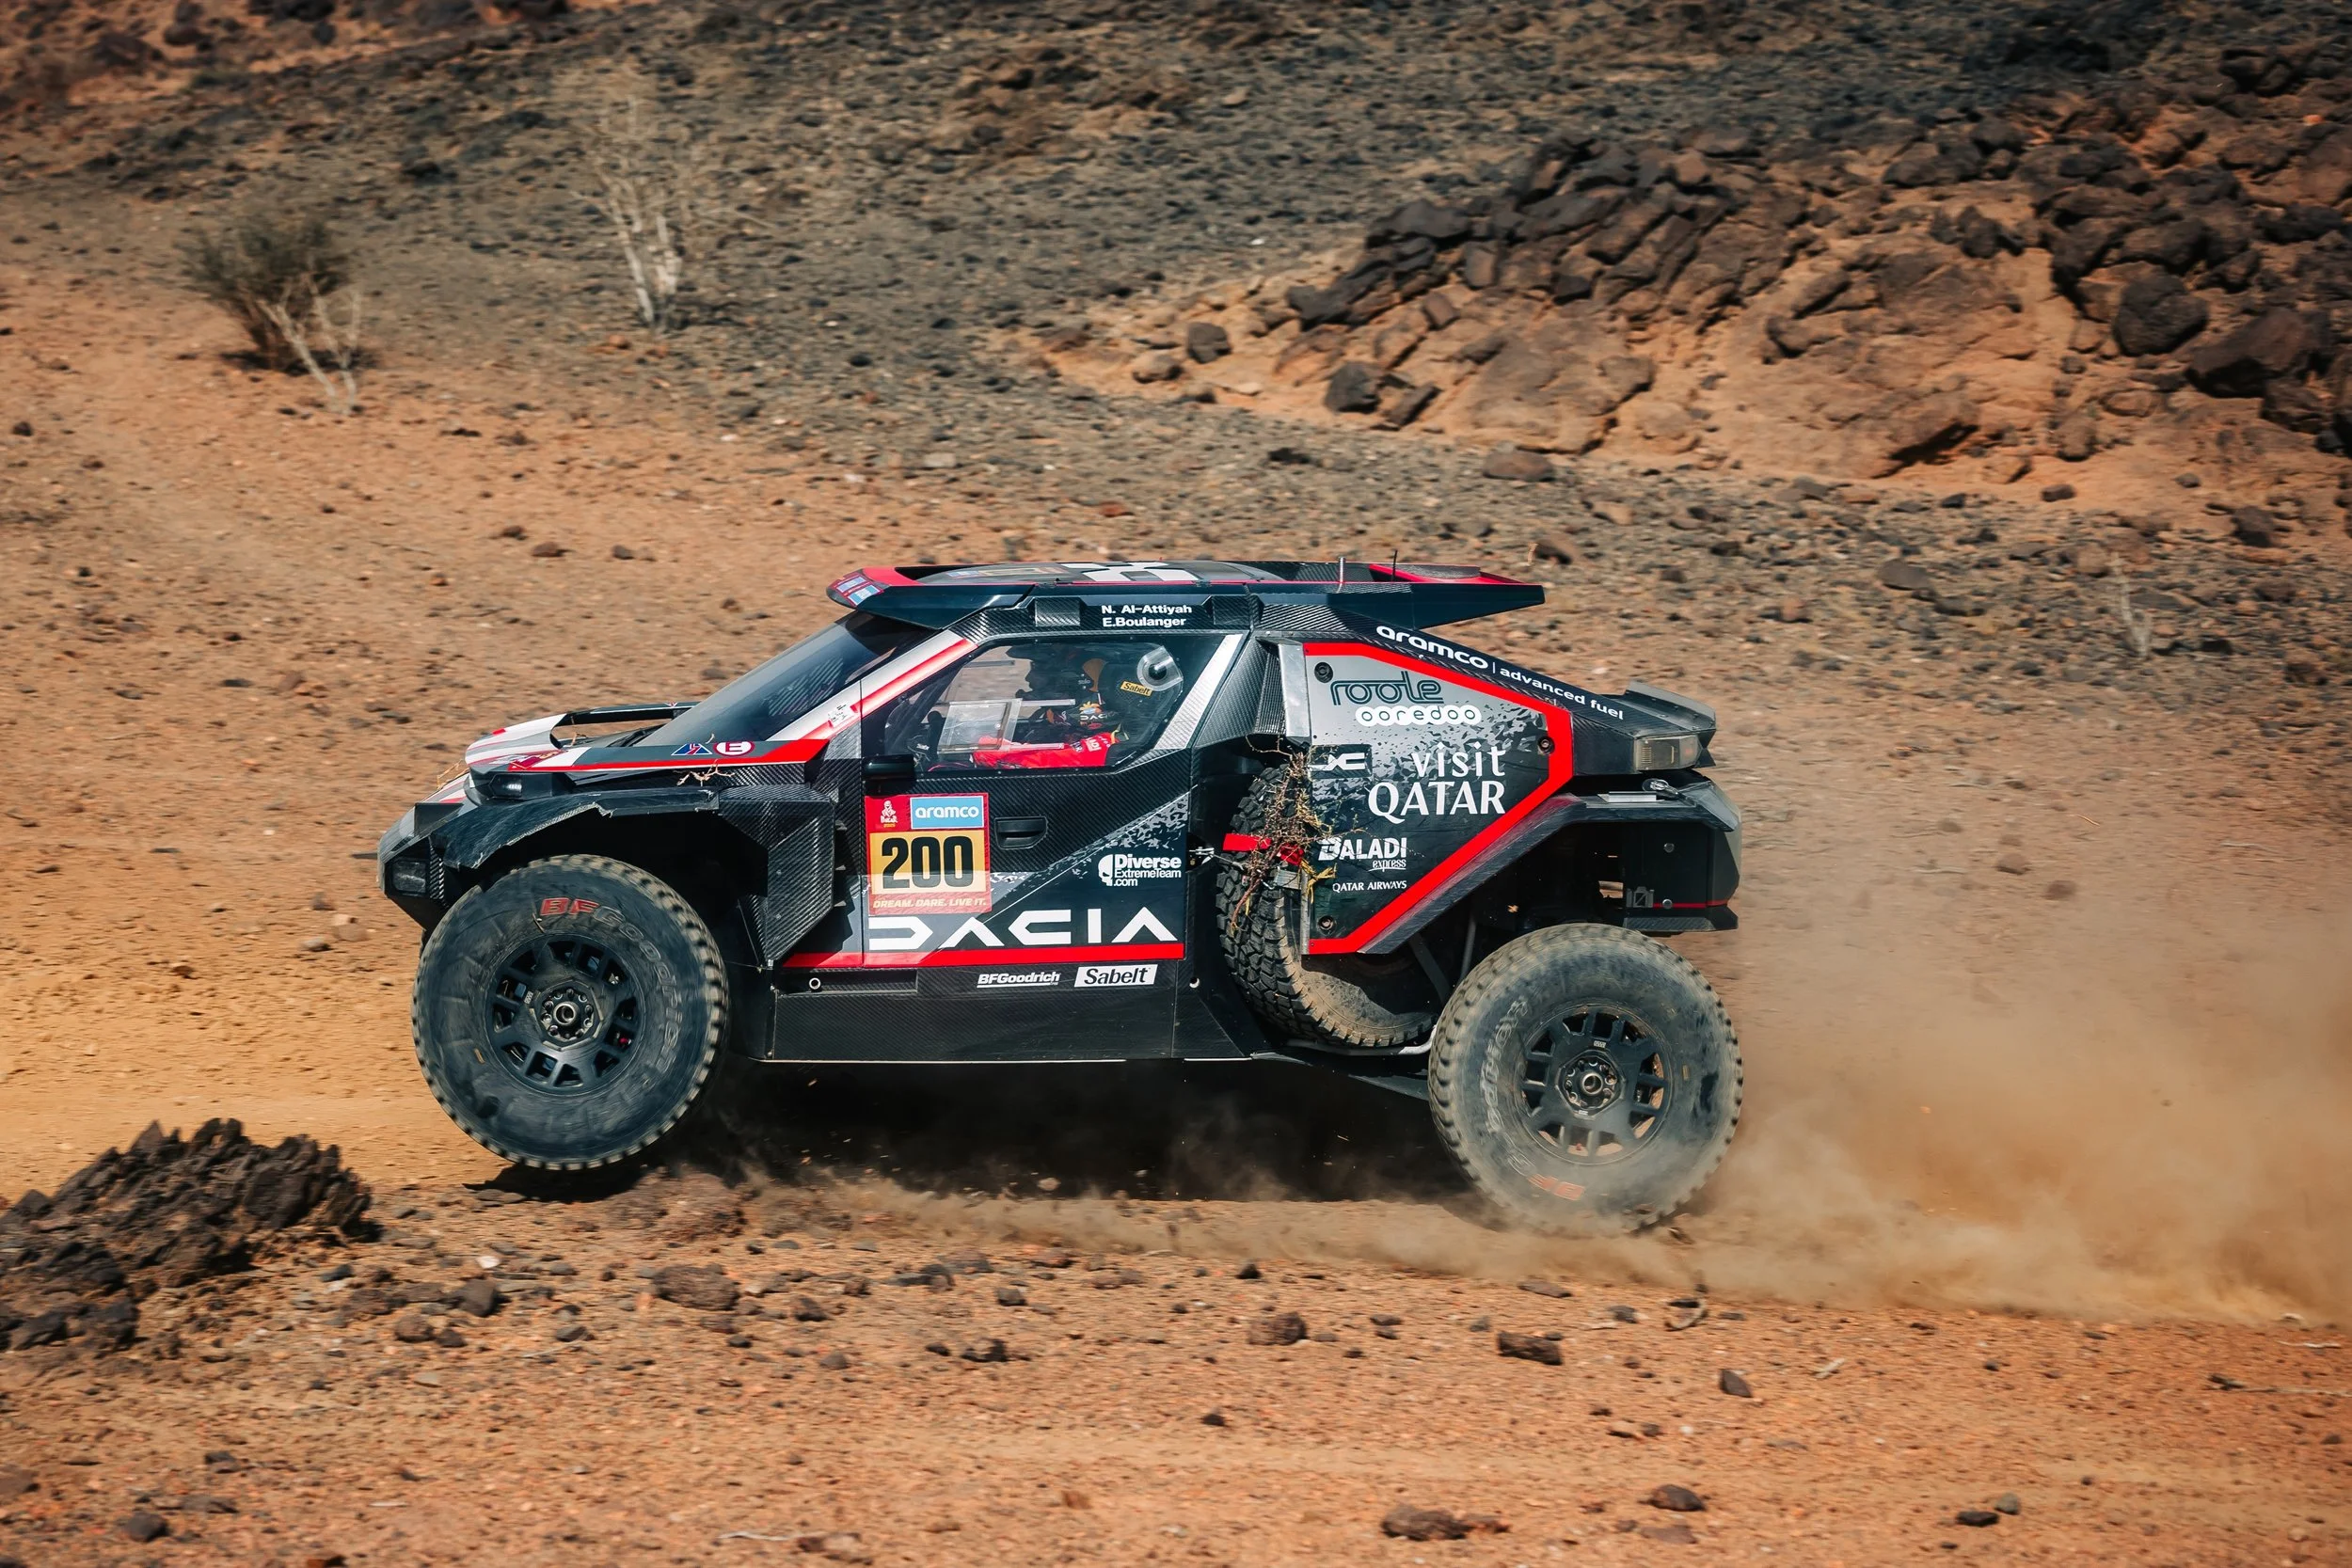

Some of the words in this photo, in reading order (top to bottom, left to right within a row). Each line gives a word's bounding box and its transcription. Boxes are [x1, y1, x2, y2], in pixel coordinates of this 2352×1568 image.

[1101, 605, 1116, 613] N.
[1120, 605, 1192, 615] Al-Attiyah
[1102, 617, 1186, 627] E.Boulanger
[1376, 626, 1488, 670] aramco
[1123, 681, 1150, 695] Sabelt
[1500, 667, 1585, 705] advanced
[1590, 700, 1624, 721] fuel
[1359, 706, 1477, 722] ooredoo
[1411, 741, 1505, 778] visit
[1368, 781, 1505, 824] QATAR
[914, 806, 979, 818] aramco
[1318, 837, 1406, 861] BALADI
[882, 835, 974, 889] 200
[1114, 853, 1182, 869] Diverse
[1372, 860, 1406, 871] express
[1114, 868, 1182, 879] ExtremeTeam
[1113, 879, 1138, 887] .com
[1332, 881, 1364, 893] QATAR
[1367, 880, 1407, 891] AIRWAYS
[872, 899, 914, 909] DREAM.
[915, 898, 947, 908] DARE.
[949, 897, 974, 907] LIVE
[975, 897, 987, 906] IT.
[868, 907, 1178, 950] DACIA
[977, 972, 1061, 985] BFGoodrich
[1084, 967, 1149, 985] Sabelt
